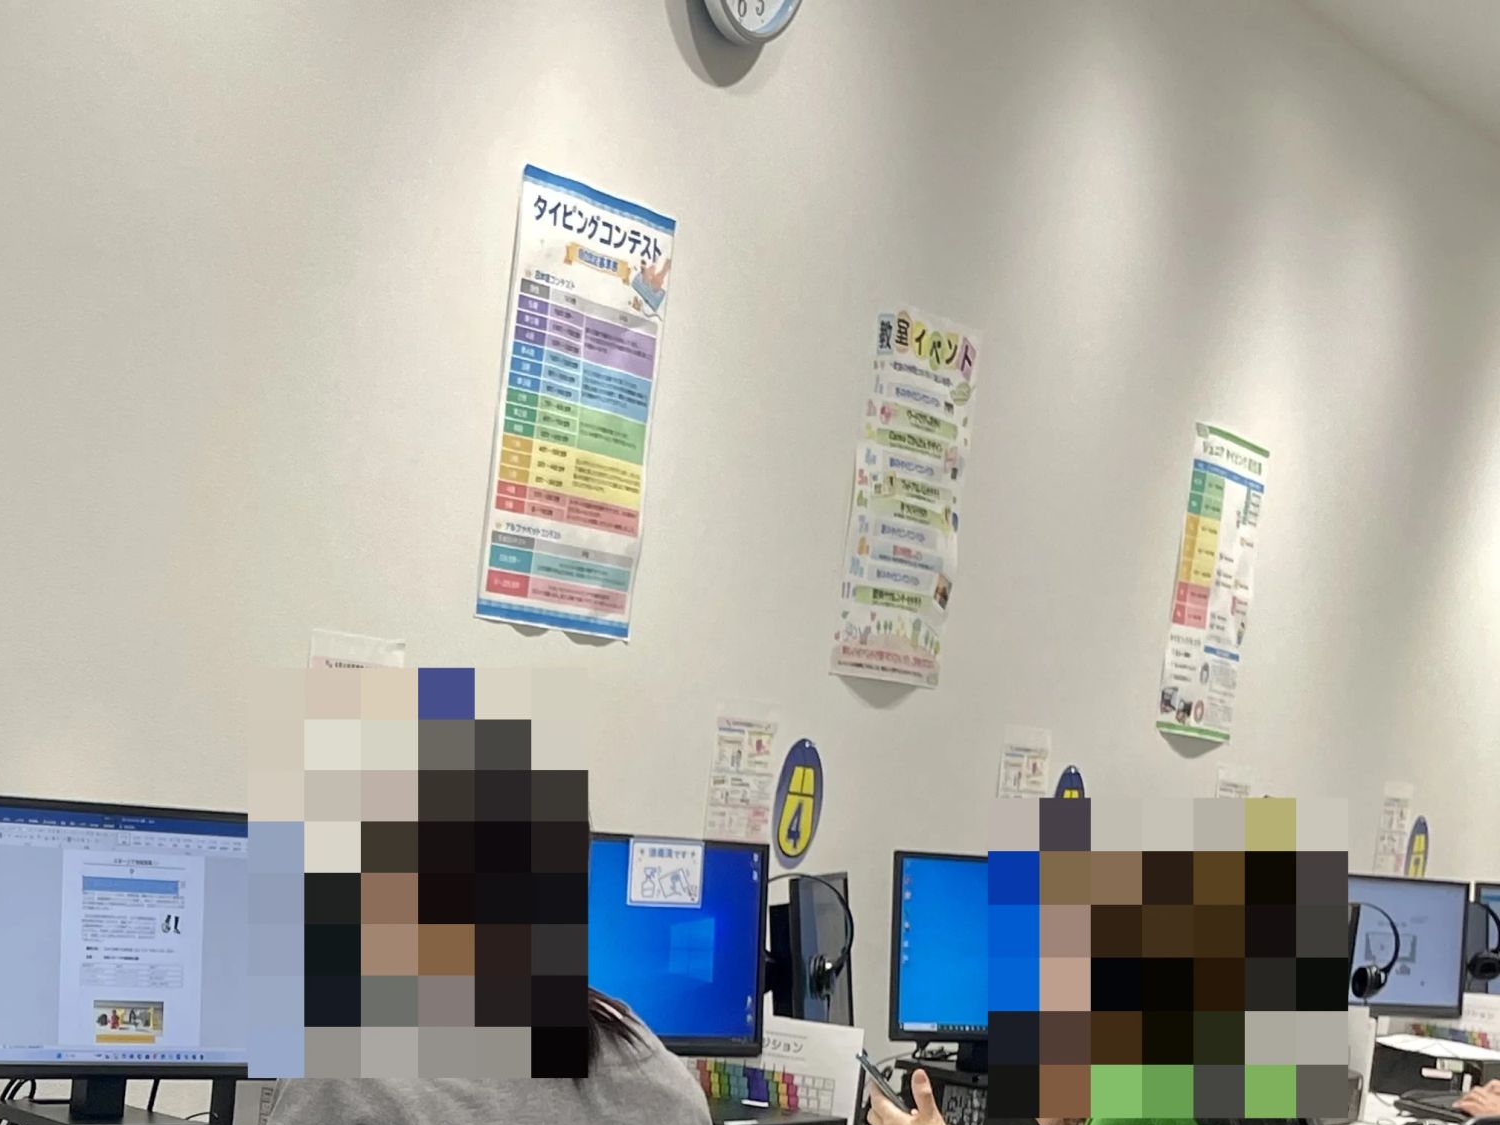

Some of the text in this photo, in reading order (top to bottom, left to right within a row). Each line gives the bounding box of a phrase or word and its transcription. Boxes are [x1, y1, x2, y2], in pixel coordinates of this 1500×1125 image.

[533, 195, 662, 263] タイピングコンテスト
[879, 318, 973, 372] 教室イベント
[787, 801, 803, 849] 4
